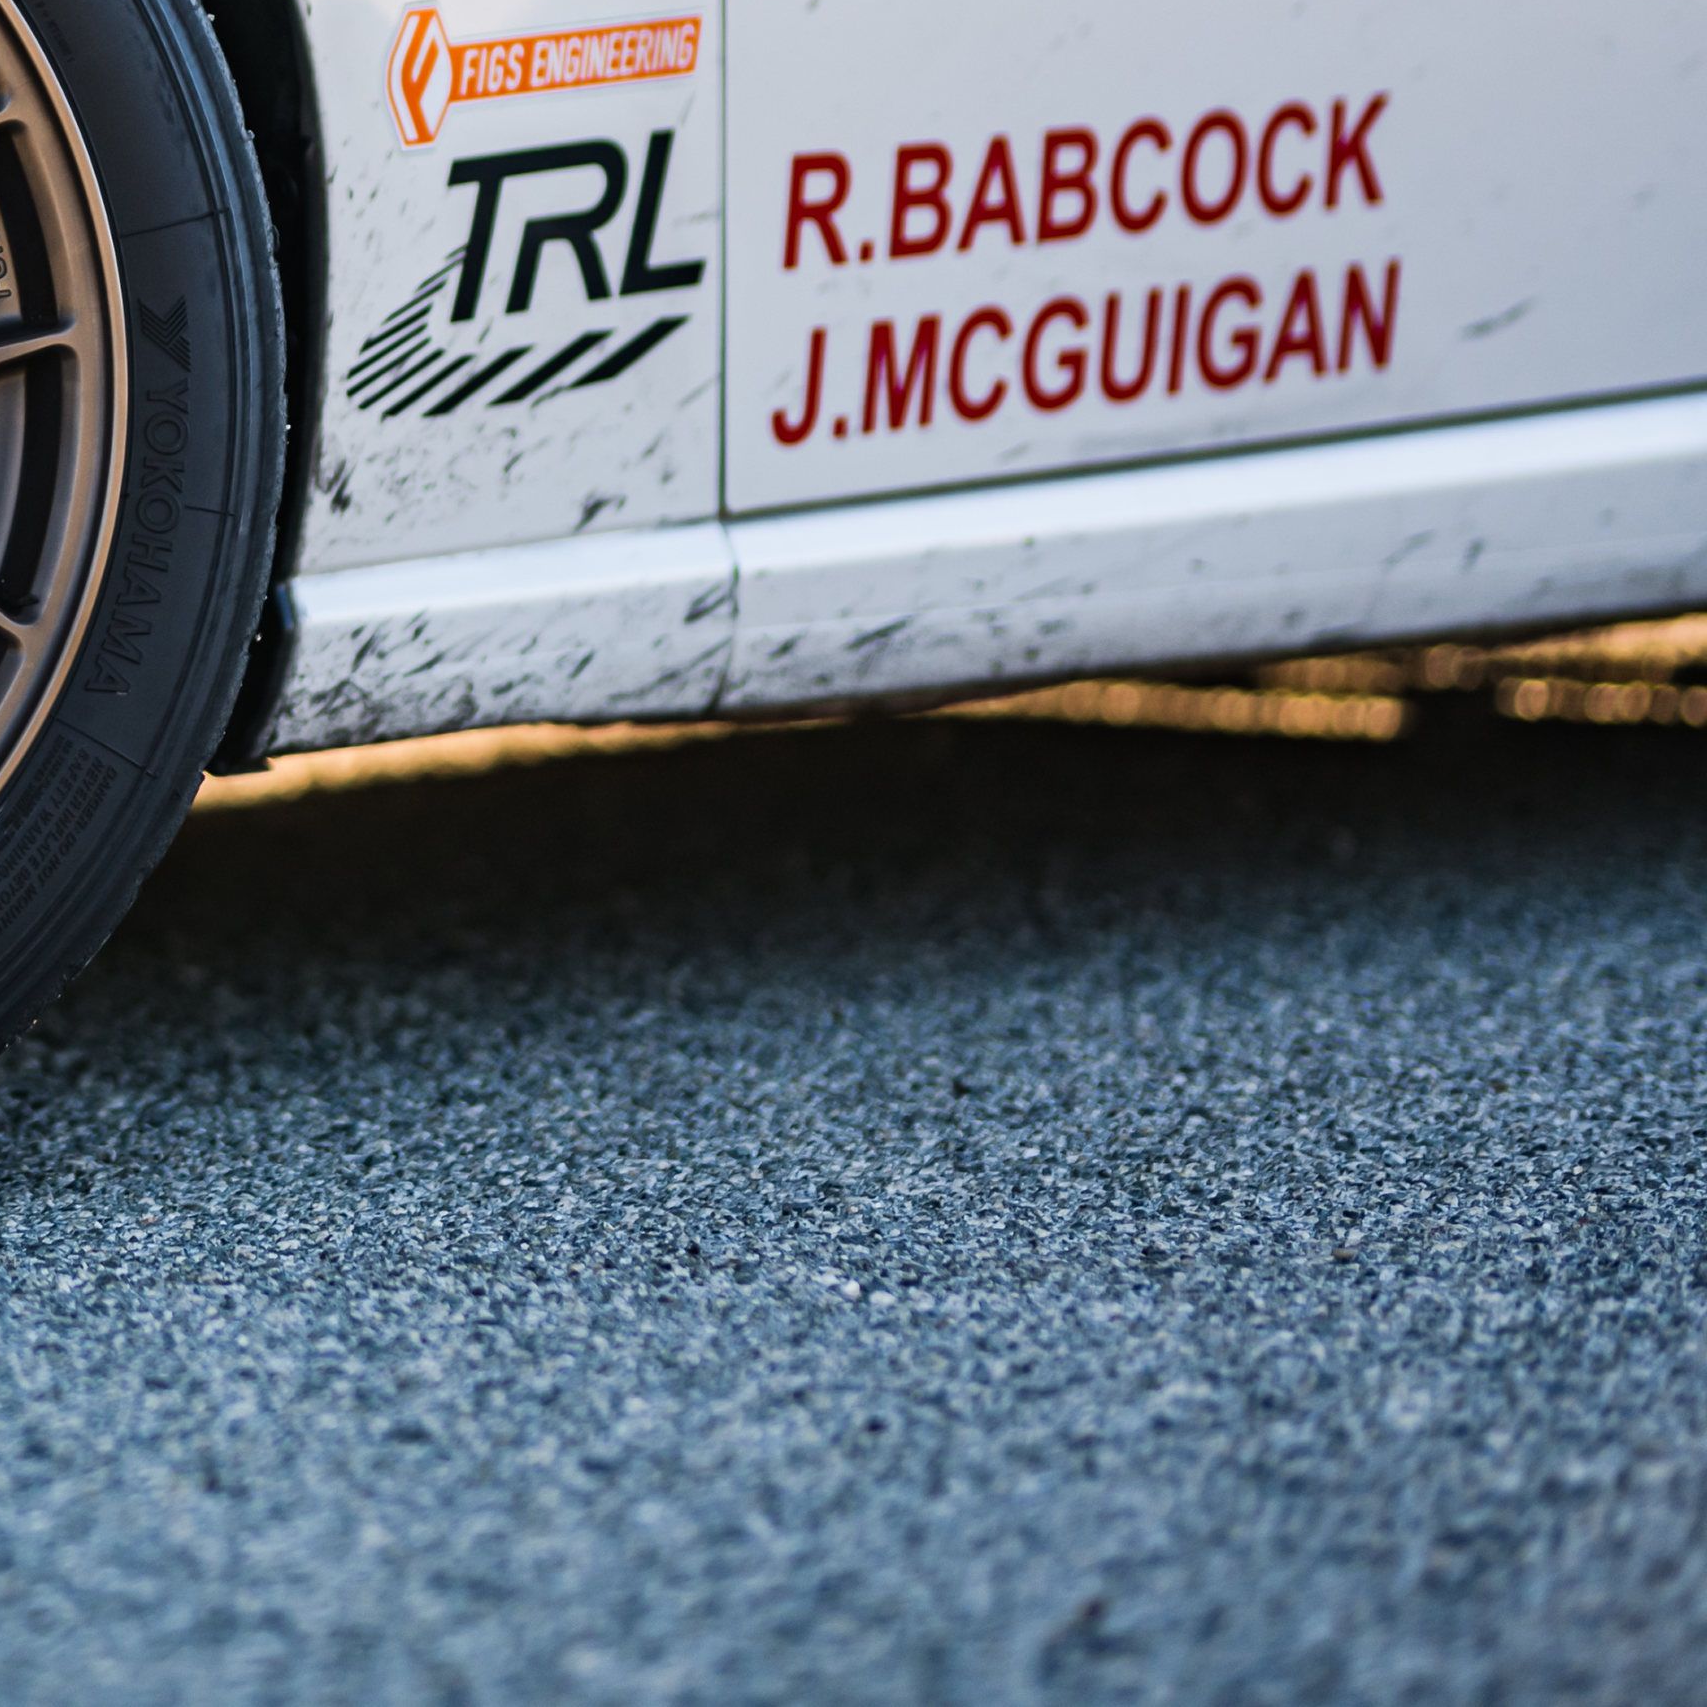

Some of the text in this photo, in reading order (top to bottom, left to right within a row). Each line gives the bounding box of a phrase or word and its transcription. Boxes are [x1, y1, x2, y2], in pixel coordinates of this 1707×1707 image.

[459, 24, 696, 96] FIGS ENGINEERING
[447, 129, 707, 323] TRL
[783, 90, 1390, 271] R.BABCOCK
[771, 257, 1402, 447] J.MCGUIGAN
[86, 373, 191, 697] YOKOHAMA
